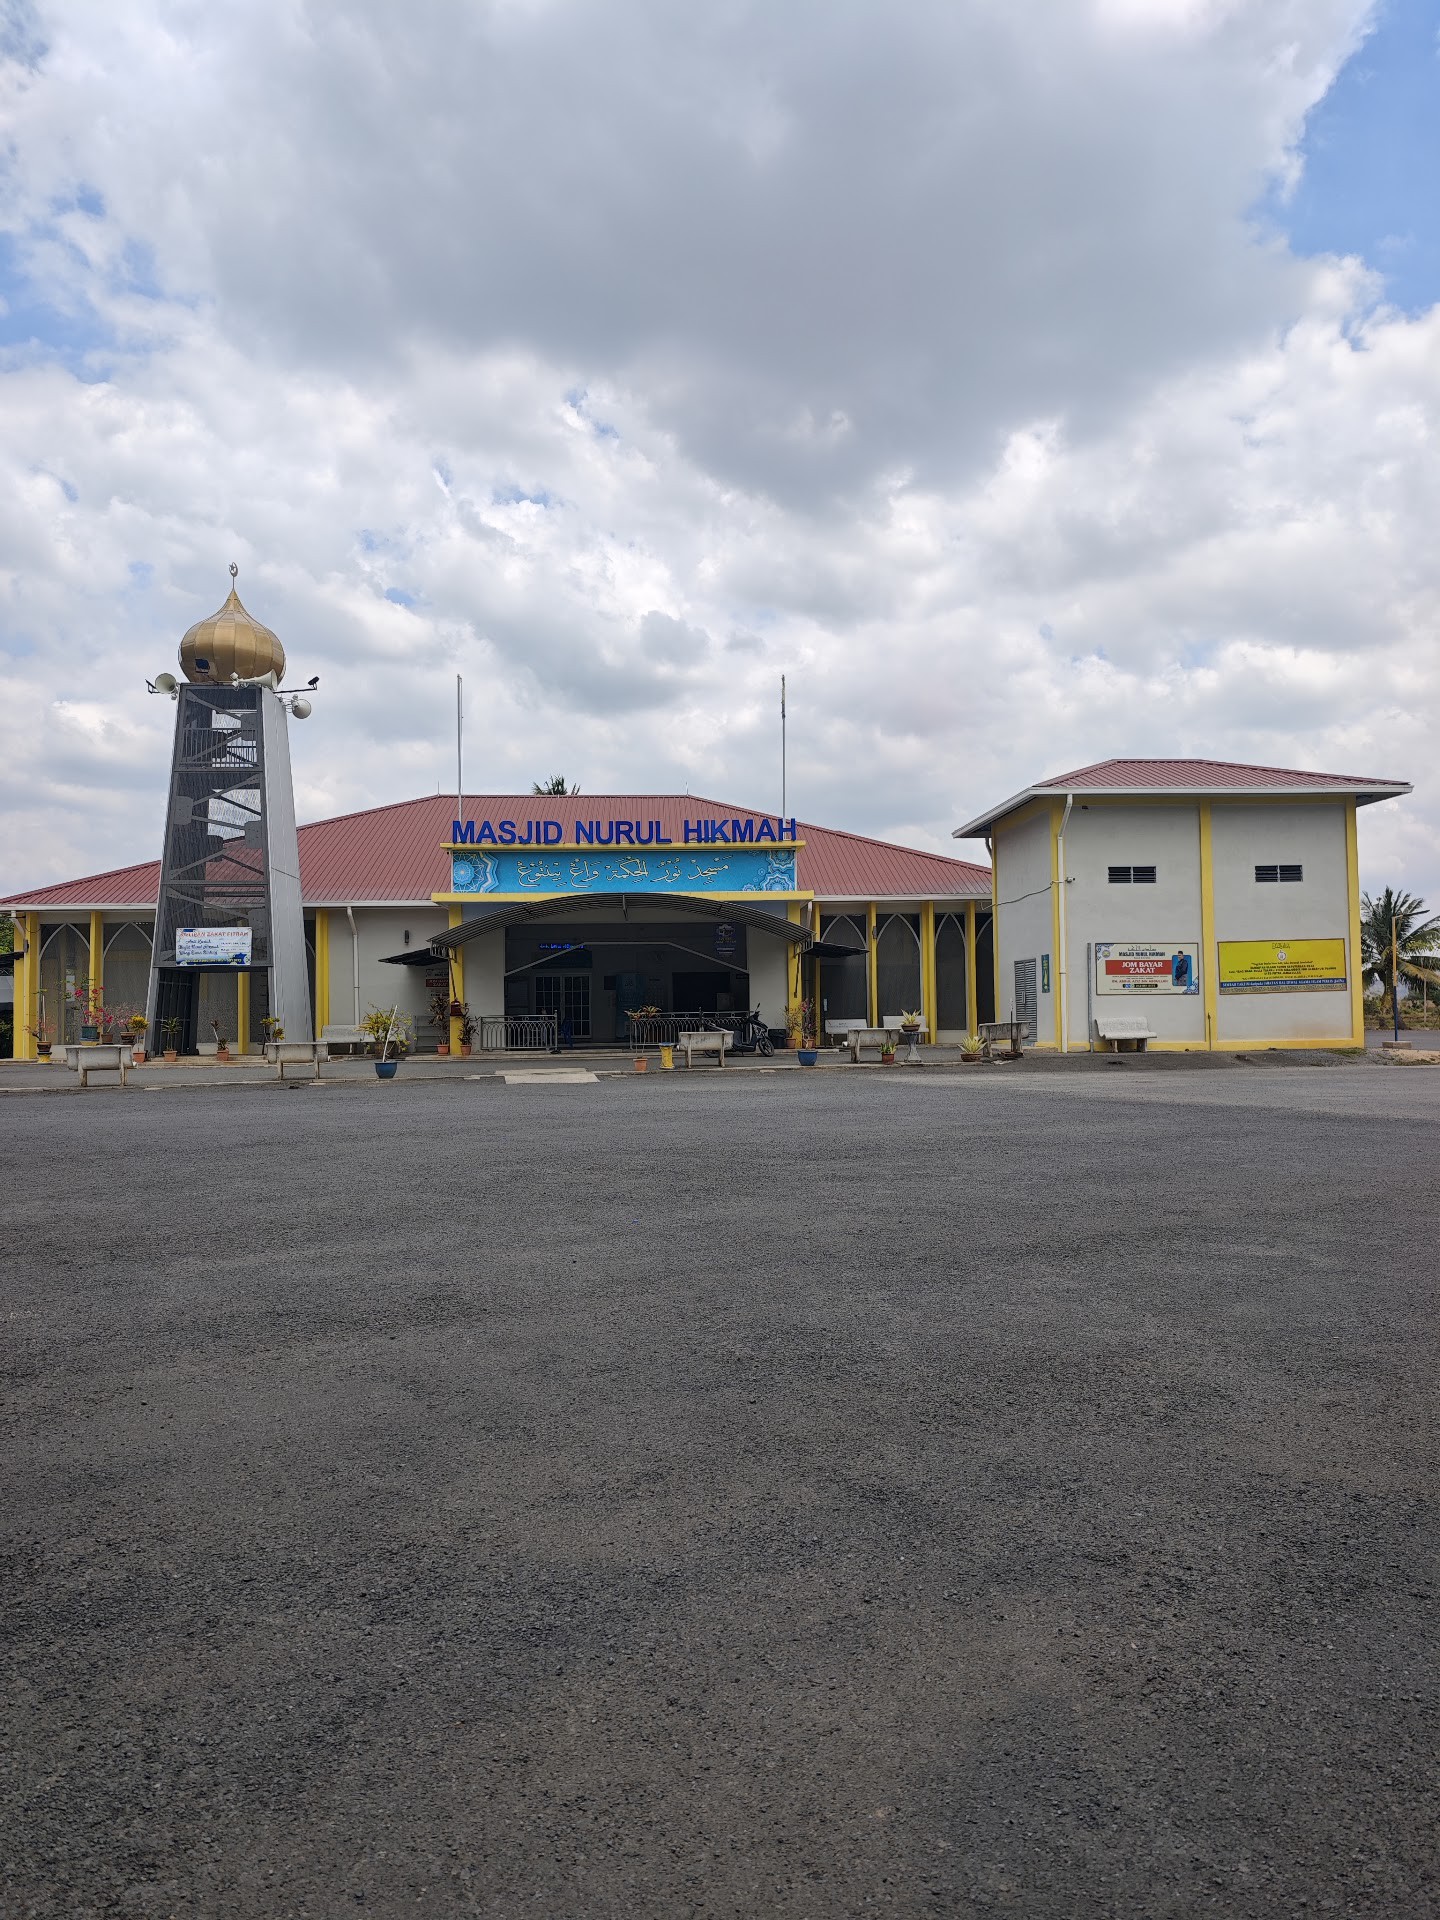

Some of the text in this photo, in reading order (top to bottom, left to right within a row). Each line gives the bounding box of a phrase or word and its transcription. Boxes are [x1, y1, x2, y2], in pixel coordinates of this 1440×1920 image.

[453, 818, 796, 844] MASJID NURUL HIKMAH
